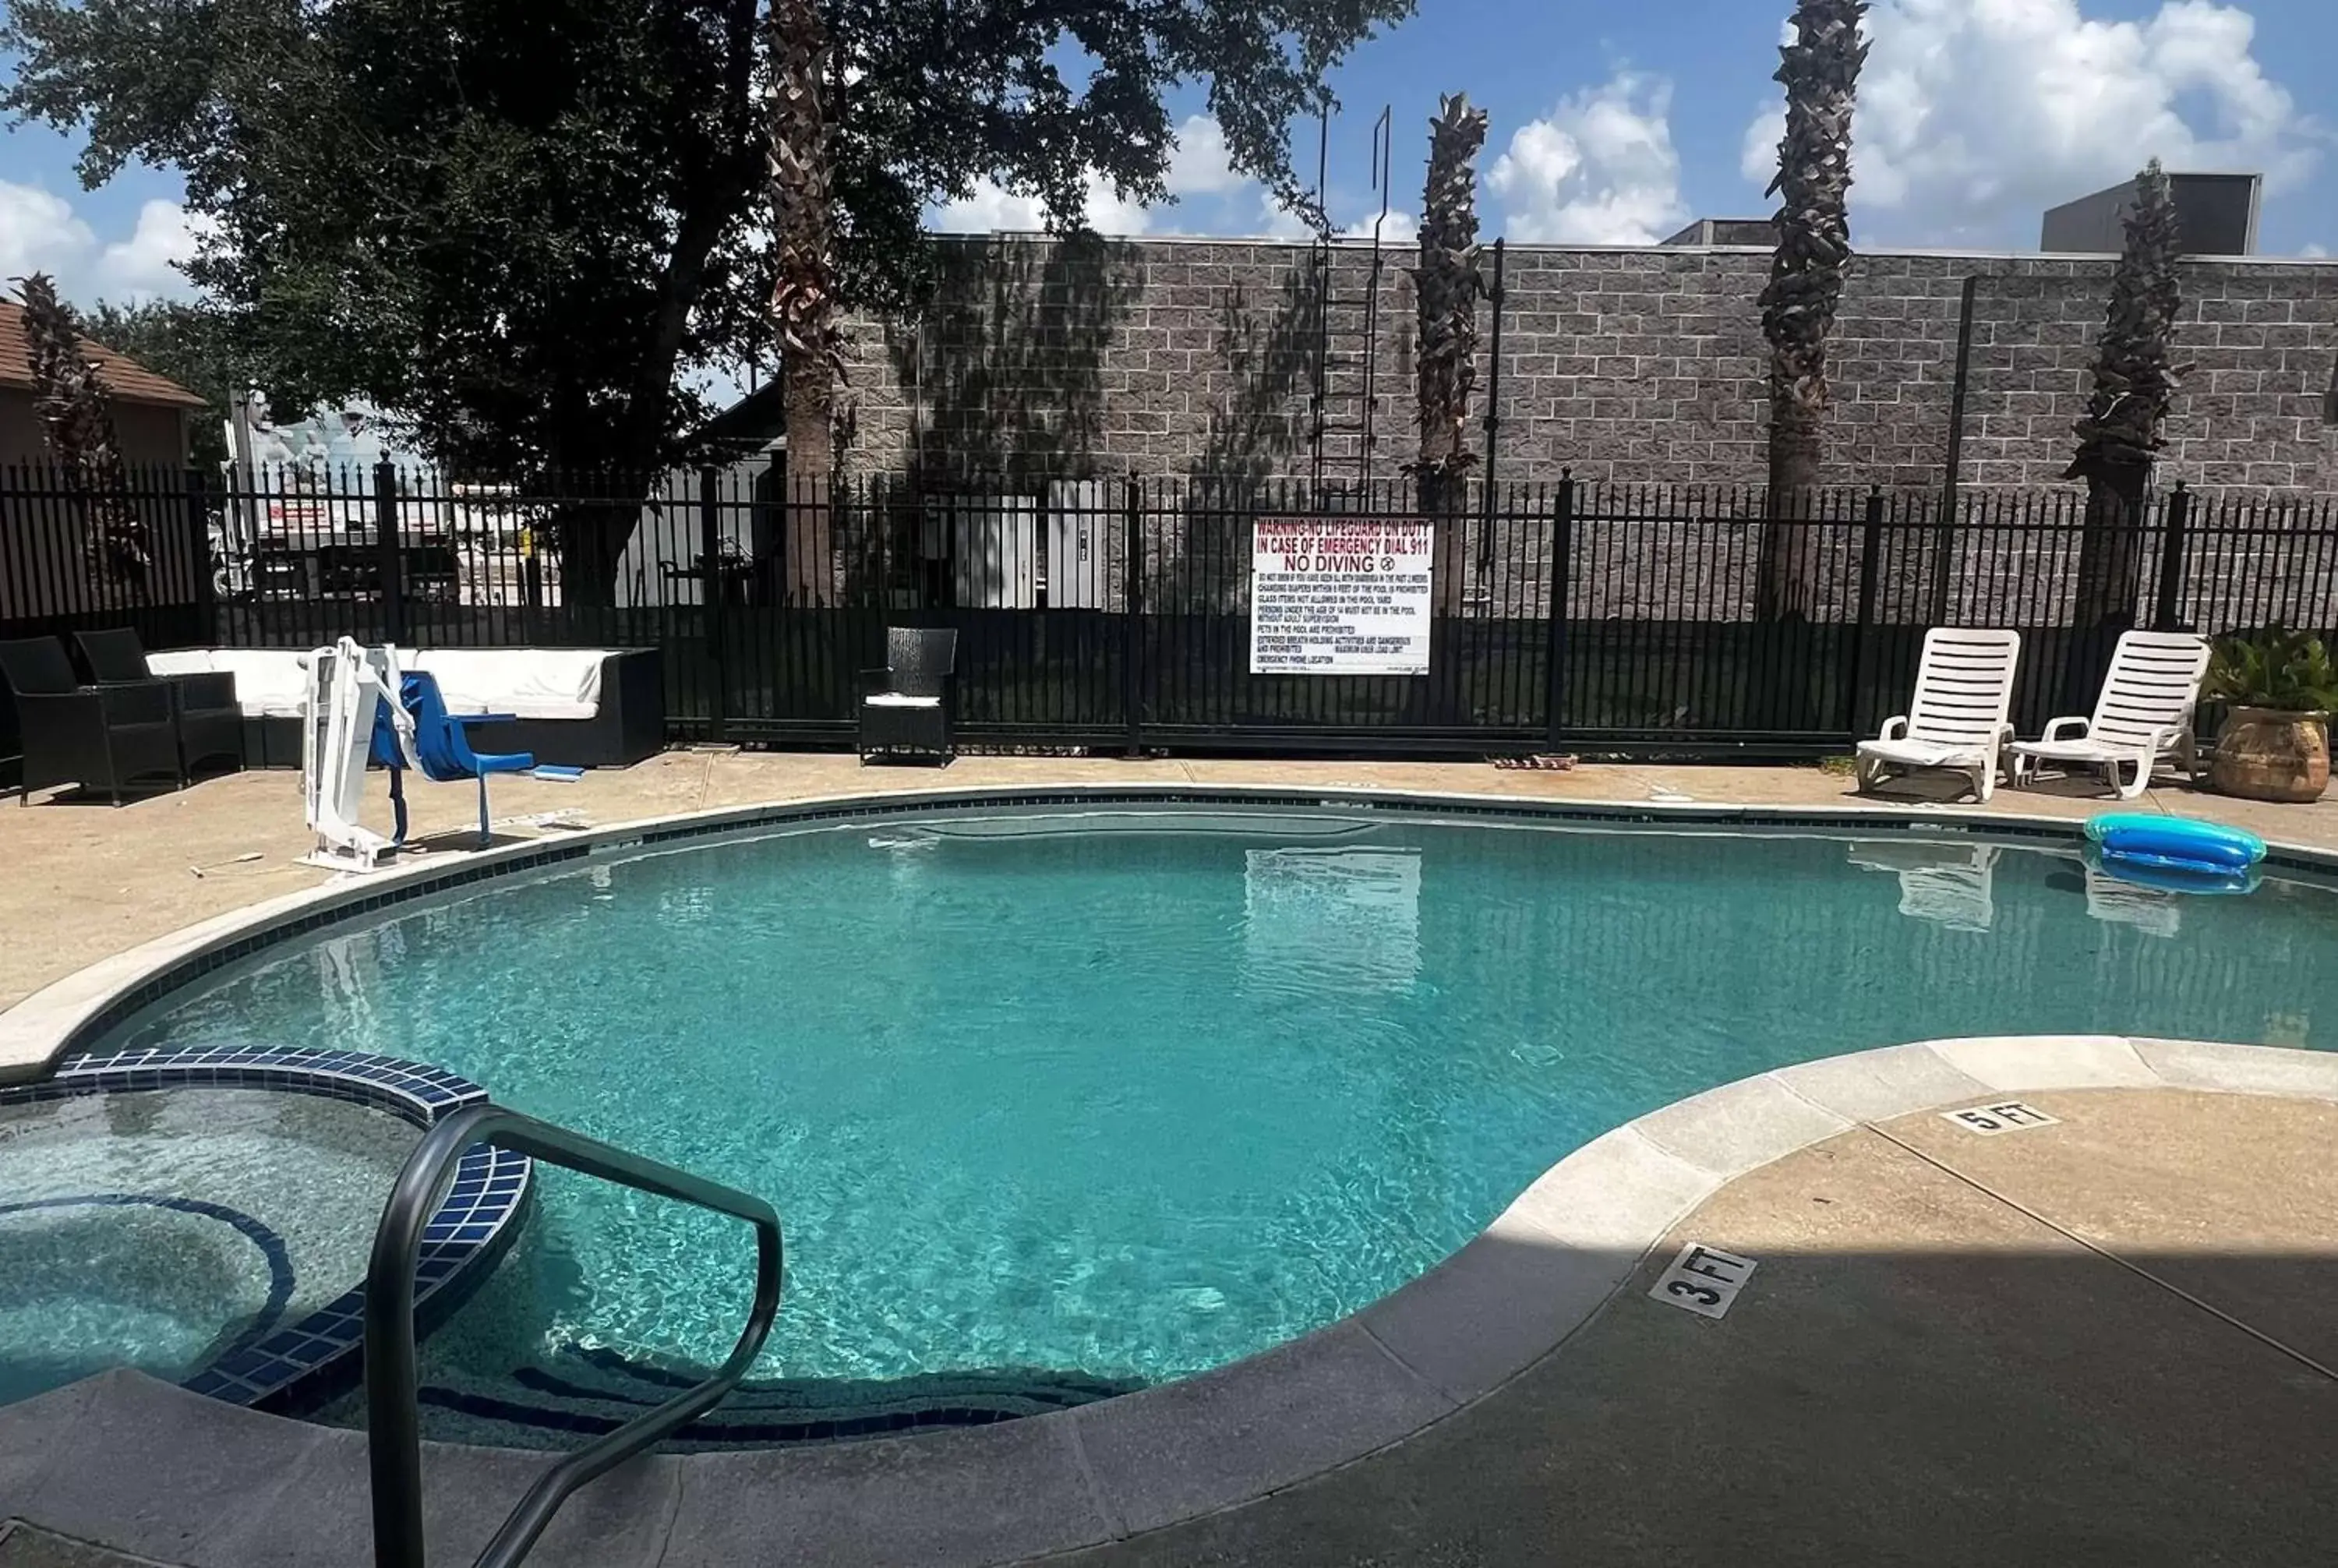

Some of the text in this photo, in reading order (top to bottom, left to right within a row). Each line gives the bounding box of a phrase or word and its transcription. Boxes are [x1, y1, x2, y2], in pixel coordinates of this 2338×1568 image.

[1326, 520, 1381, 536] LIFEGUARD
[1384, 521, 1398, 536] ON
[1402, 521, 1429, 537] DUTY
[1257, 538, 1429, 555] IN CASE OF EMERGENCY DIAL 911
[1284, 555, 1374, 572] NO DIVING
[1955, 1104, 2051, 1129] 5 FT
[1667, 1247, 1744, 1305] 3 FT
